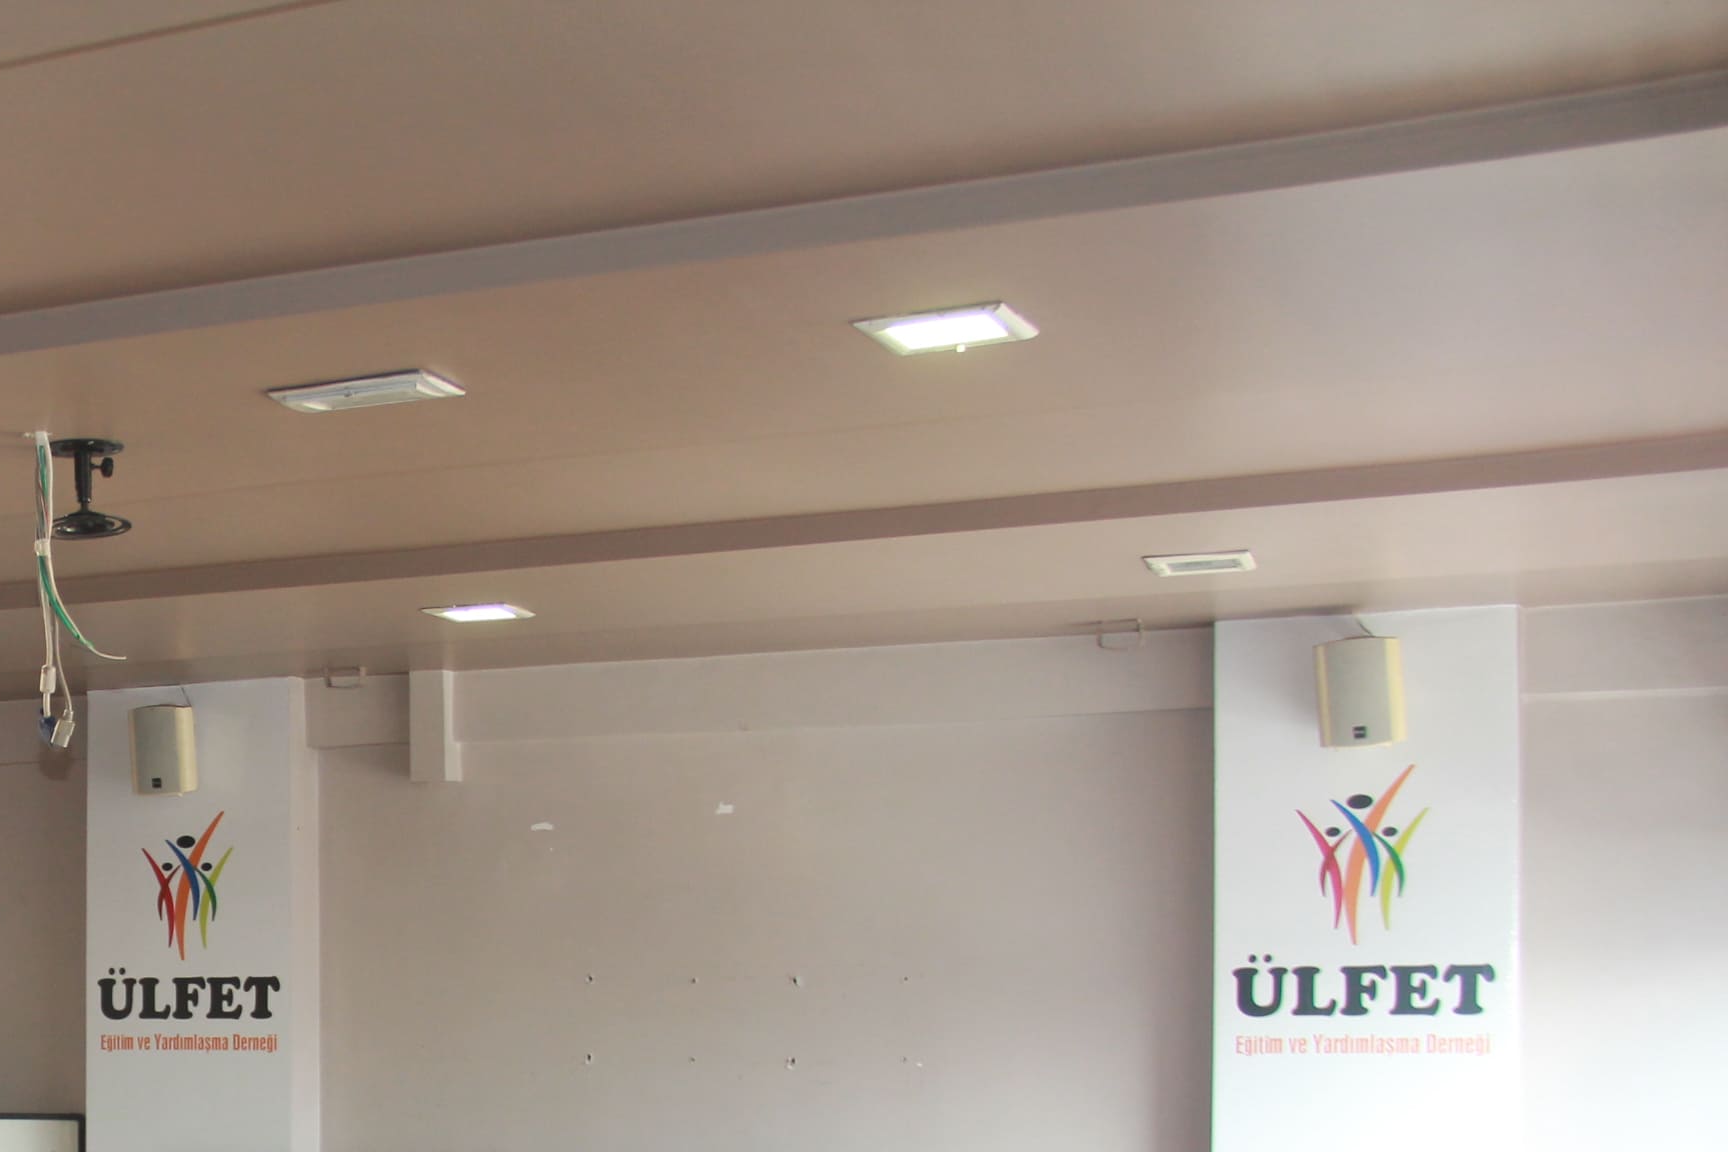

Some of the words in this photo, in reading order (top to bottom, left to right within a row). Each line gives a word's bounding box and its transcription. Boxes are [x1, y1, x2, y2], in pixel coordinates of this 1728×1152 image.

[97, 967, 281, 1020] ÜLFET
[1231, 953, 1497, 1018] ÜLFET
[100, 1034, 134, 1053] Eğitim
[137, 1036, 151, 1051] ve
[154, 1033, 229, 1054] Yardımlaşma
[233, 1033, 278, 1053] Derneği
[1235, 1034, 1283, 1056] Eğitim
[1289, 1038, 1308, 1054] ve
[1312, 1033, 1421, 1057] Yardımlaşma
[1426, 1033, 1491, 1057] Derneği
